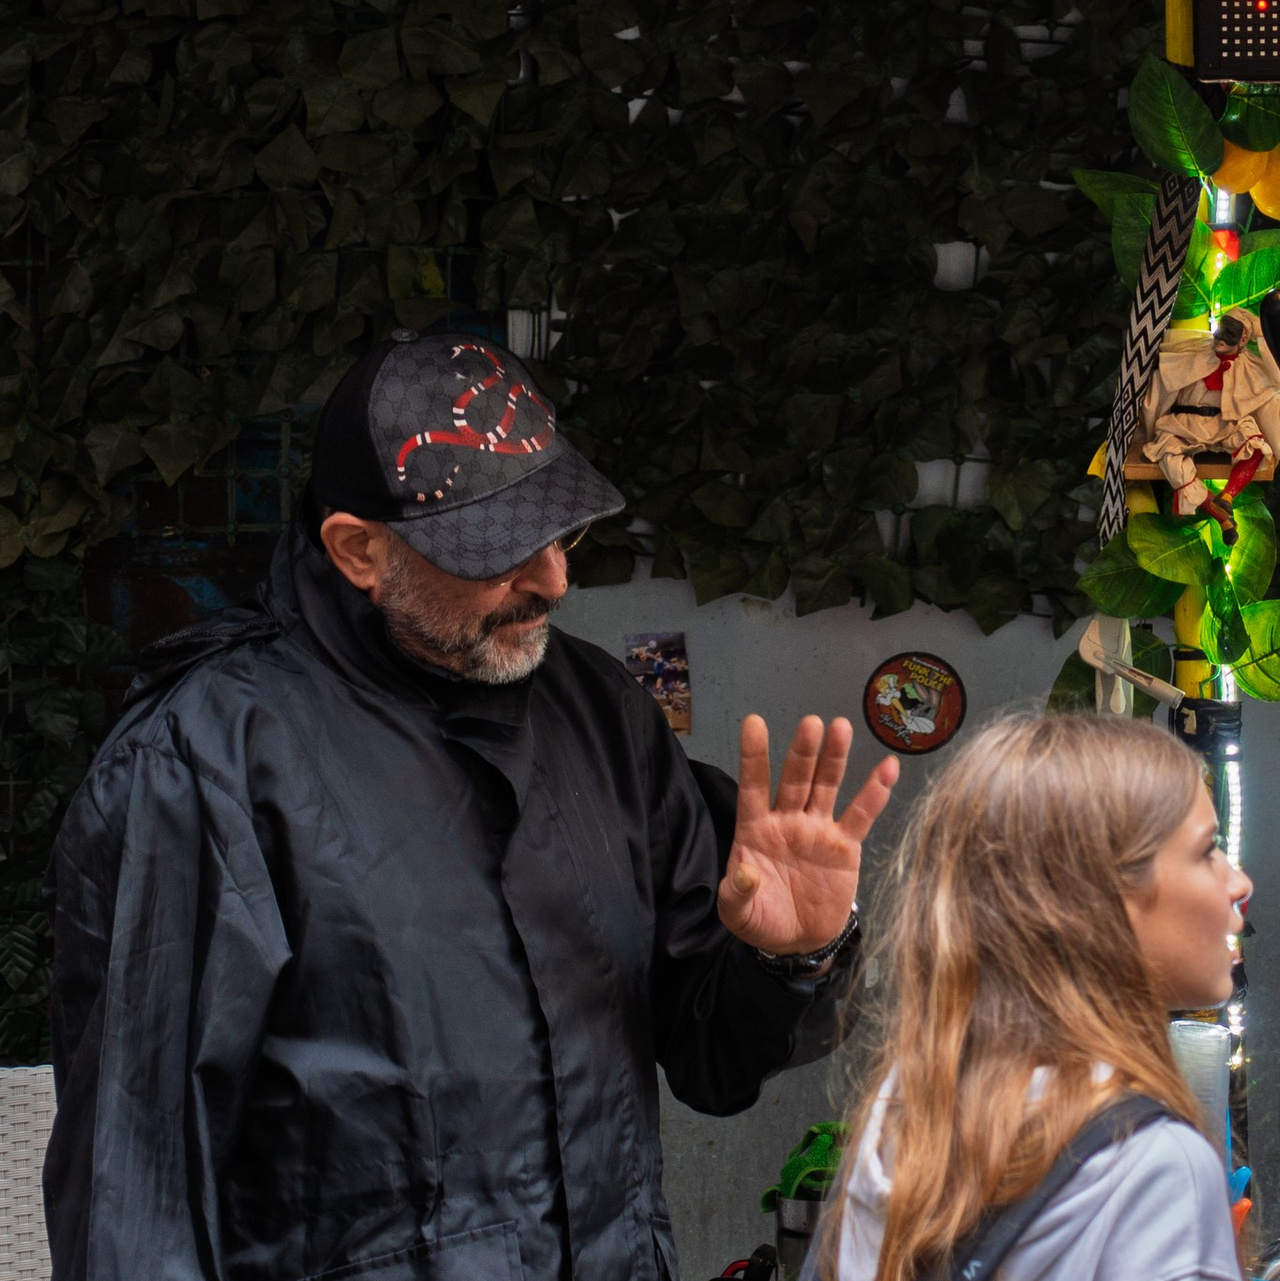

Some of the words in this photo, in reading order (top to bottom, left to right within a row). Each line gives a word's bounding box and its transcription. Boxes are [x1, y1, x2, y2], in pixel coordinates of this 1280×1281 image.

[902, 660, 931, 676] FUNK
[932, 670, 955, 686] THE
[909, 672, 945, 692] POLICE
